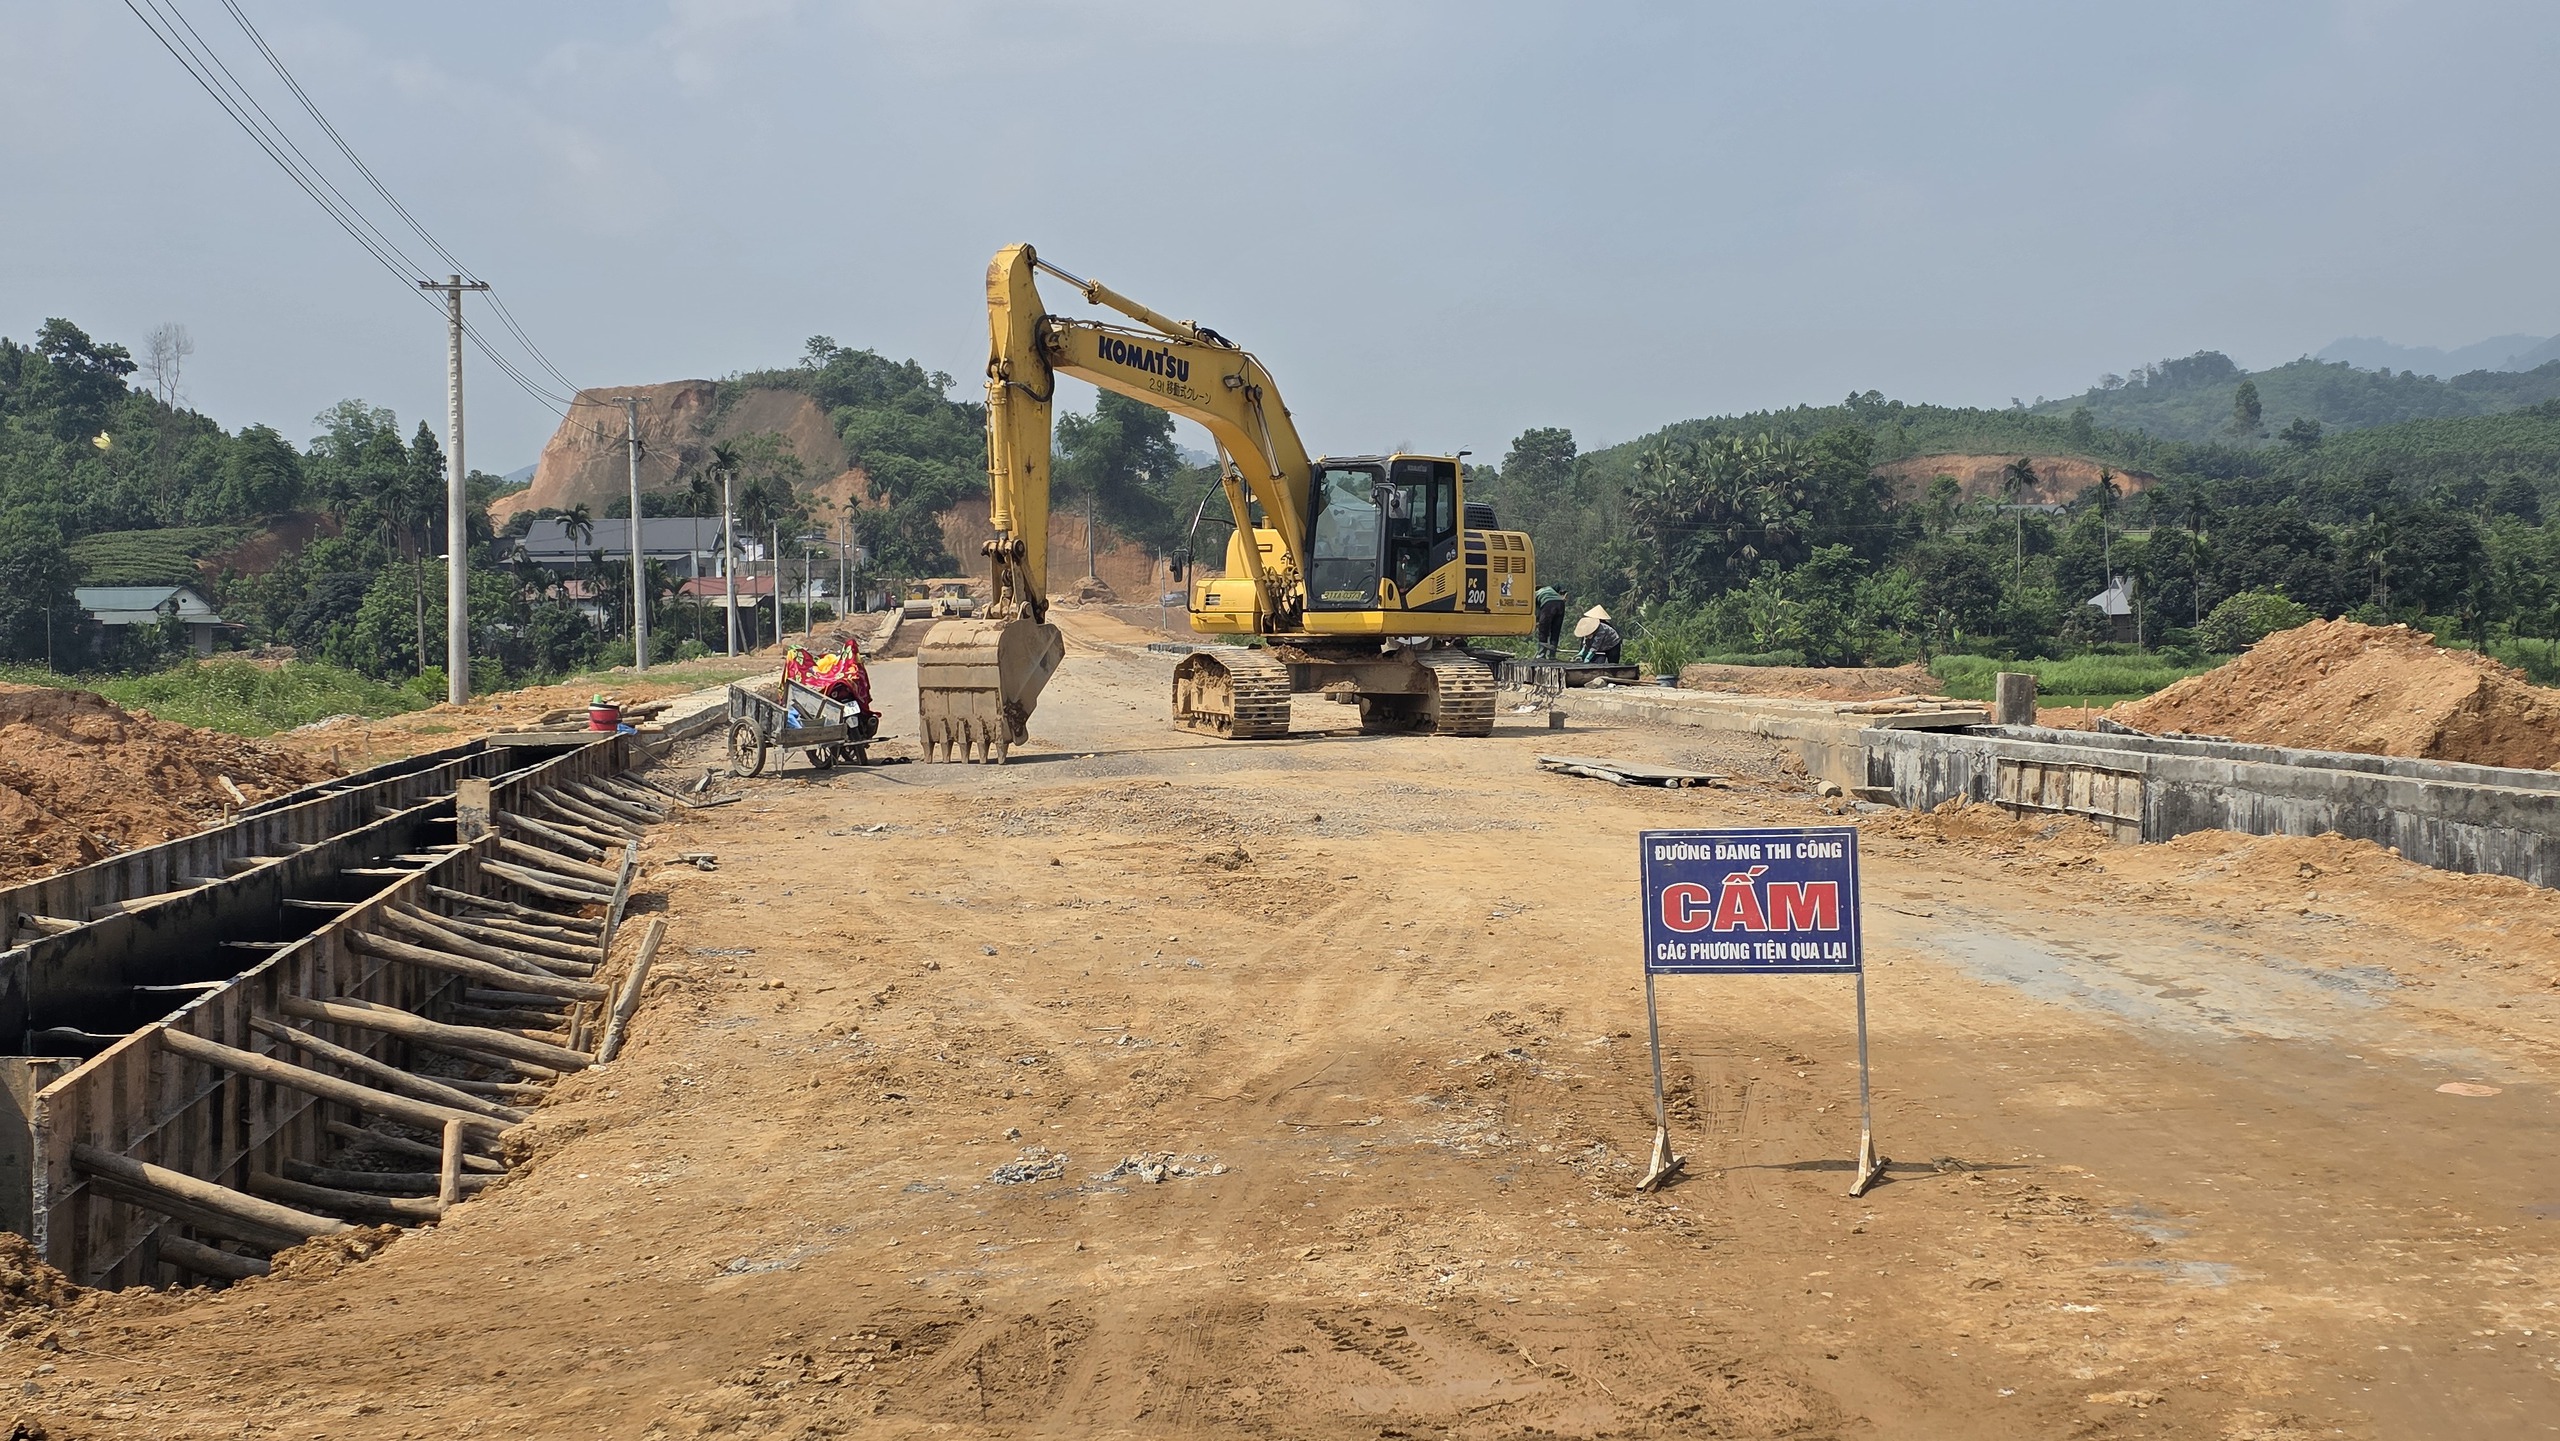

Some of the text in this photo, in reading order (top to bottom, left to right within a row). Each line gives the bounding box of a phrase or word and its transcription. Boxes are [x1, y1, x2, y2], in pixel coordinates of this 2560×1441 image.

[1098, 335, 1189, 382] KOMATSU
[1468, 578, 1478, 588] PC
[1467, 590, 1485, 604] 200
[1654, 840, 1842, 861] ĐƯỜNG ĐANG THI CÔNG
[1661, 865, 1840, 933] CẤM
[1657, 939, 1847, 963] CÁC PHƯƠNG TIỆN QUA LẠI
